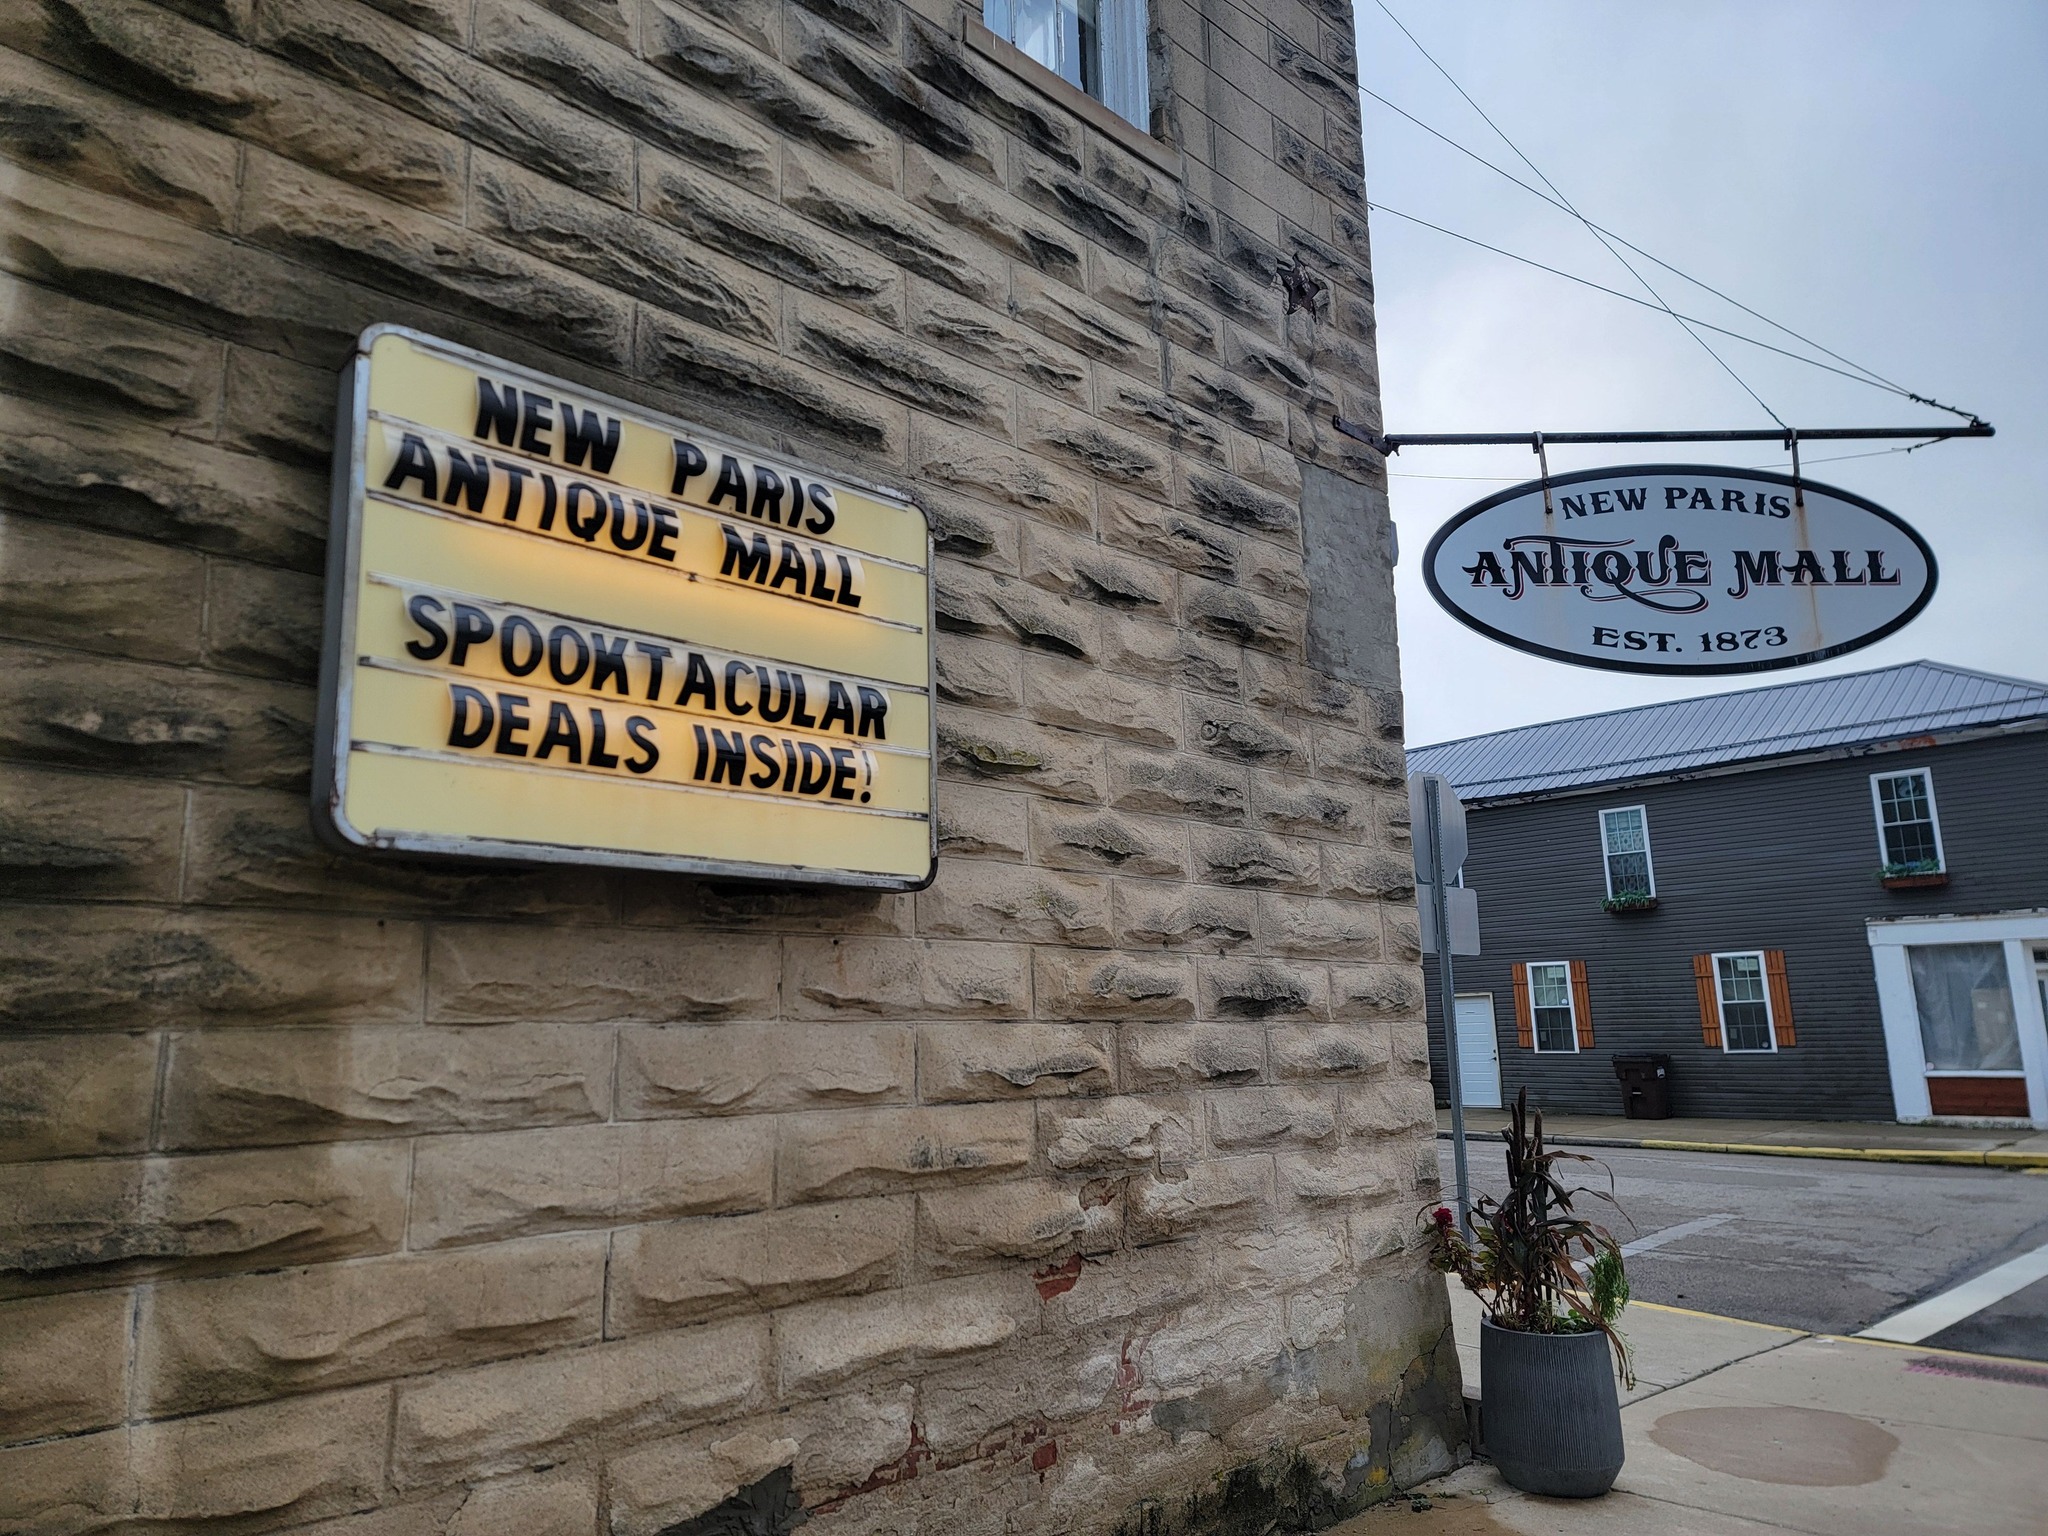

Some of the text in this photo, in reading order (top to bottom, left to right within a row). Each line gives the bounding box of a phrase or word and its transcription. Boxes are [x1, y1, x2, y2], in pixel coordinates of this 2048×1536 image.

[474, 377, 836, 535] NEW PARIS
[1559, 486, 1791, 520] NEW PARIS
[384, 433, 862, 608] ANTIQUE MALL
[1462, 534, 1900, 614] ANTIQUE MALL
[405, 594, 888, 739] SPOOKTACULAR
[1592, 626, 1788, 653] EST. 1873
[447, 683, 872, 804] DEALS INSIDE!
